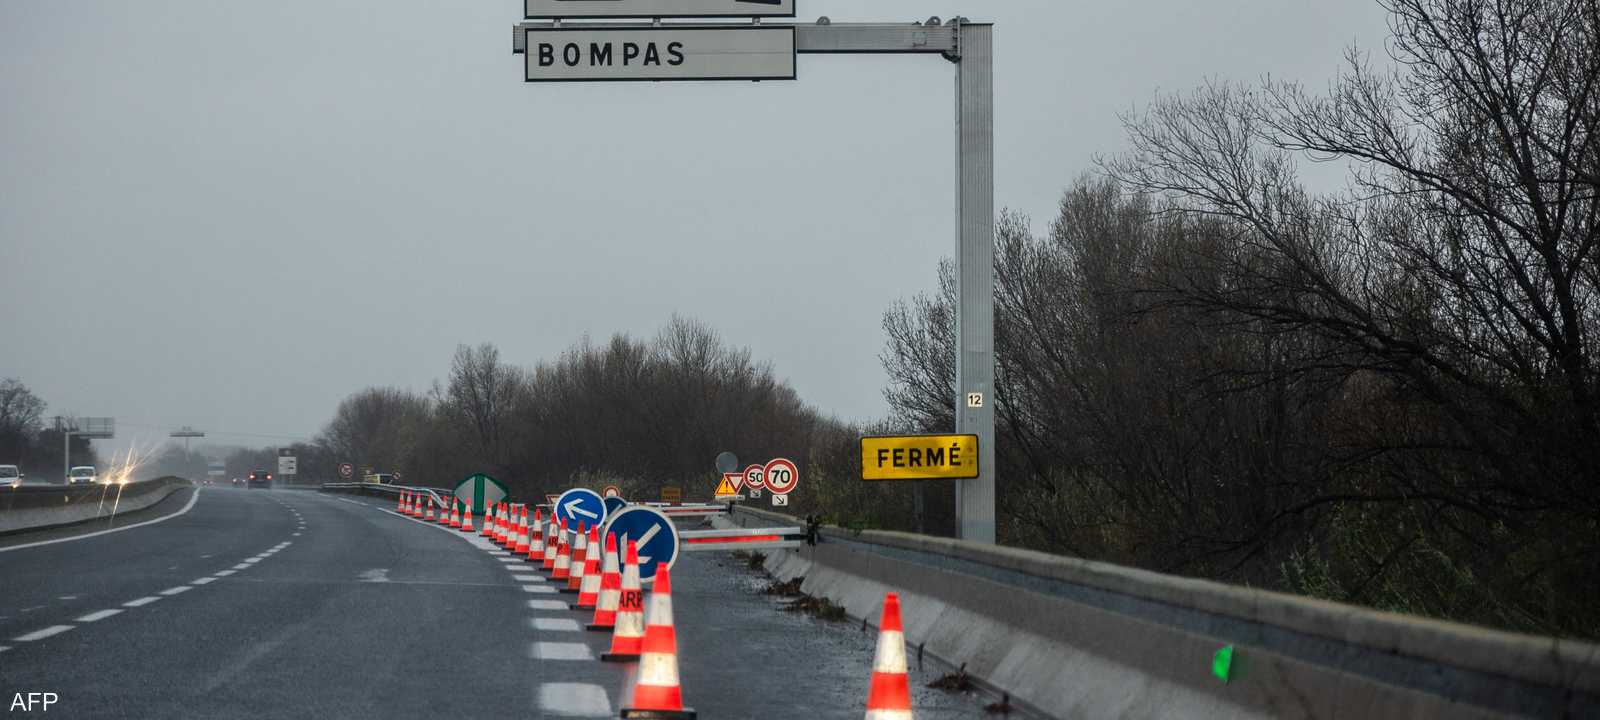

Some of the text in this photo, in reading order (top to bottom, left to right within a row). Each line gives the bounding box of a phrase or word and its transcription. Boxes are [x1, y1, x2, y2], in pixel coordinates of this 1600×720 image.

[538, 42, 685, 67] BOMPAS
[968, 395, 981, 405] 12
[877, 442, 961, 468] FERMÉ
[749, 472, 763, 483] 50
[771, 470, 790, 484] 70
